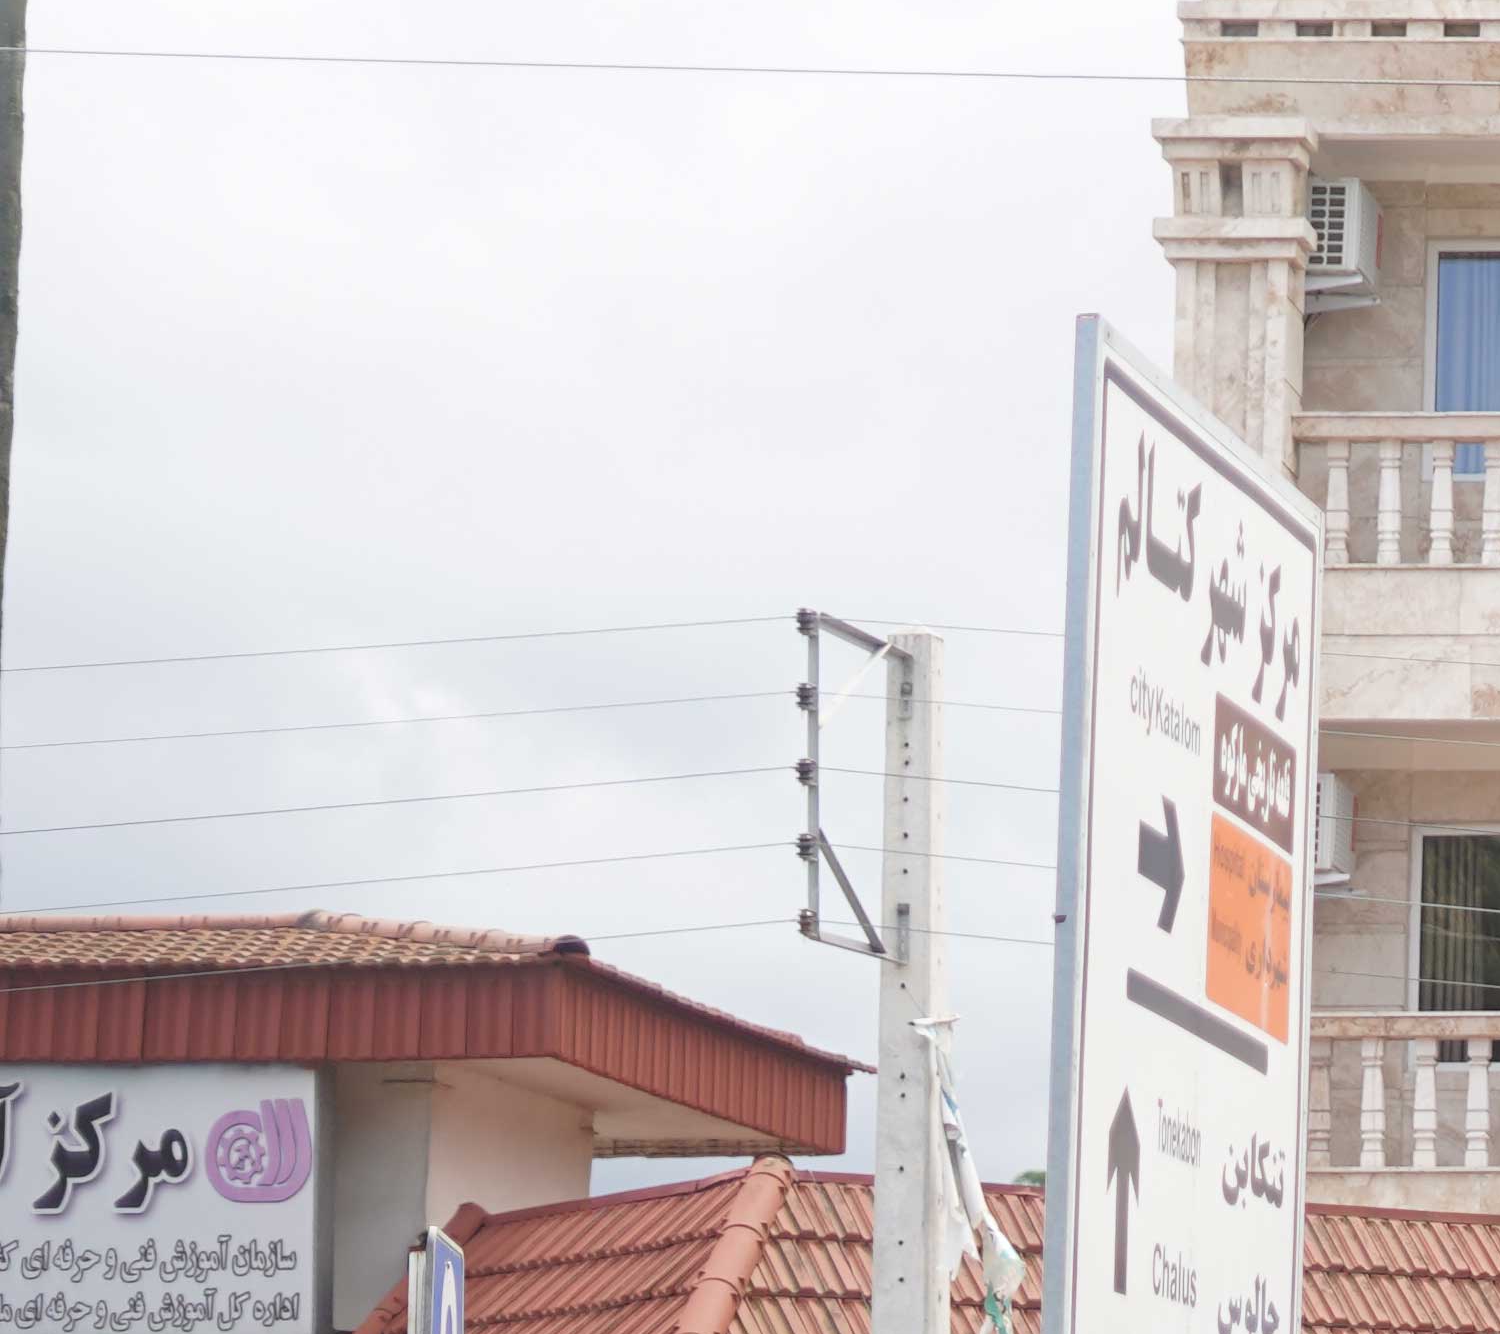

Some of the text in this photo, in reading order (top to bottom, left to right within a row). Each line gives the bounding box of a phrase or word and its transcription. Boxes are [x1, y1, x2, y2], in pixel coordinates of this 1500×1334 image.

[1115, 429, 1301, 724] مرکز شهر کتالم
[32, 1091, 193, 1216] مرکز
[1156, 1097, 1202, 1170] Tonekabon
[1220, 1131, 1286, 1210] تنکابن
[103, 1247, 117, 1279] و
[120, 1238, 157, 1283] فنی
[159, 1234, 232, 1283] آموزش
[232, 1238, 297, 1277] سازمان
[1152, 1242, 1198, 1310] Chalus
[93, 1299, 108, 1329] و
[110, 1291, 147, 1332] فنی
[147, 1287, 218, 1332] آموزش
[216, 1292, 251, 1331] کل
[252, 1292, 300, 1327] اداره
